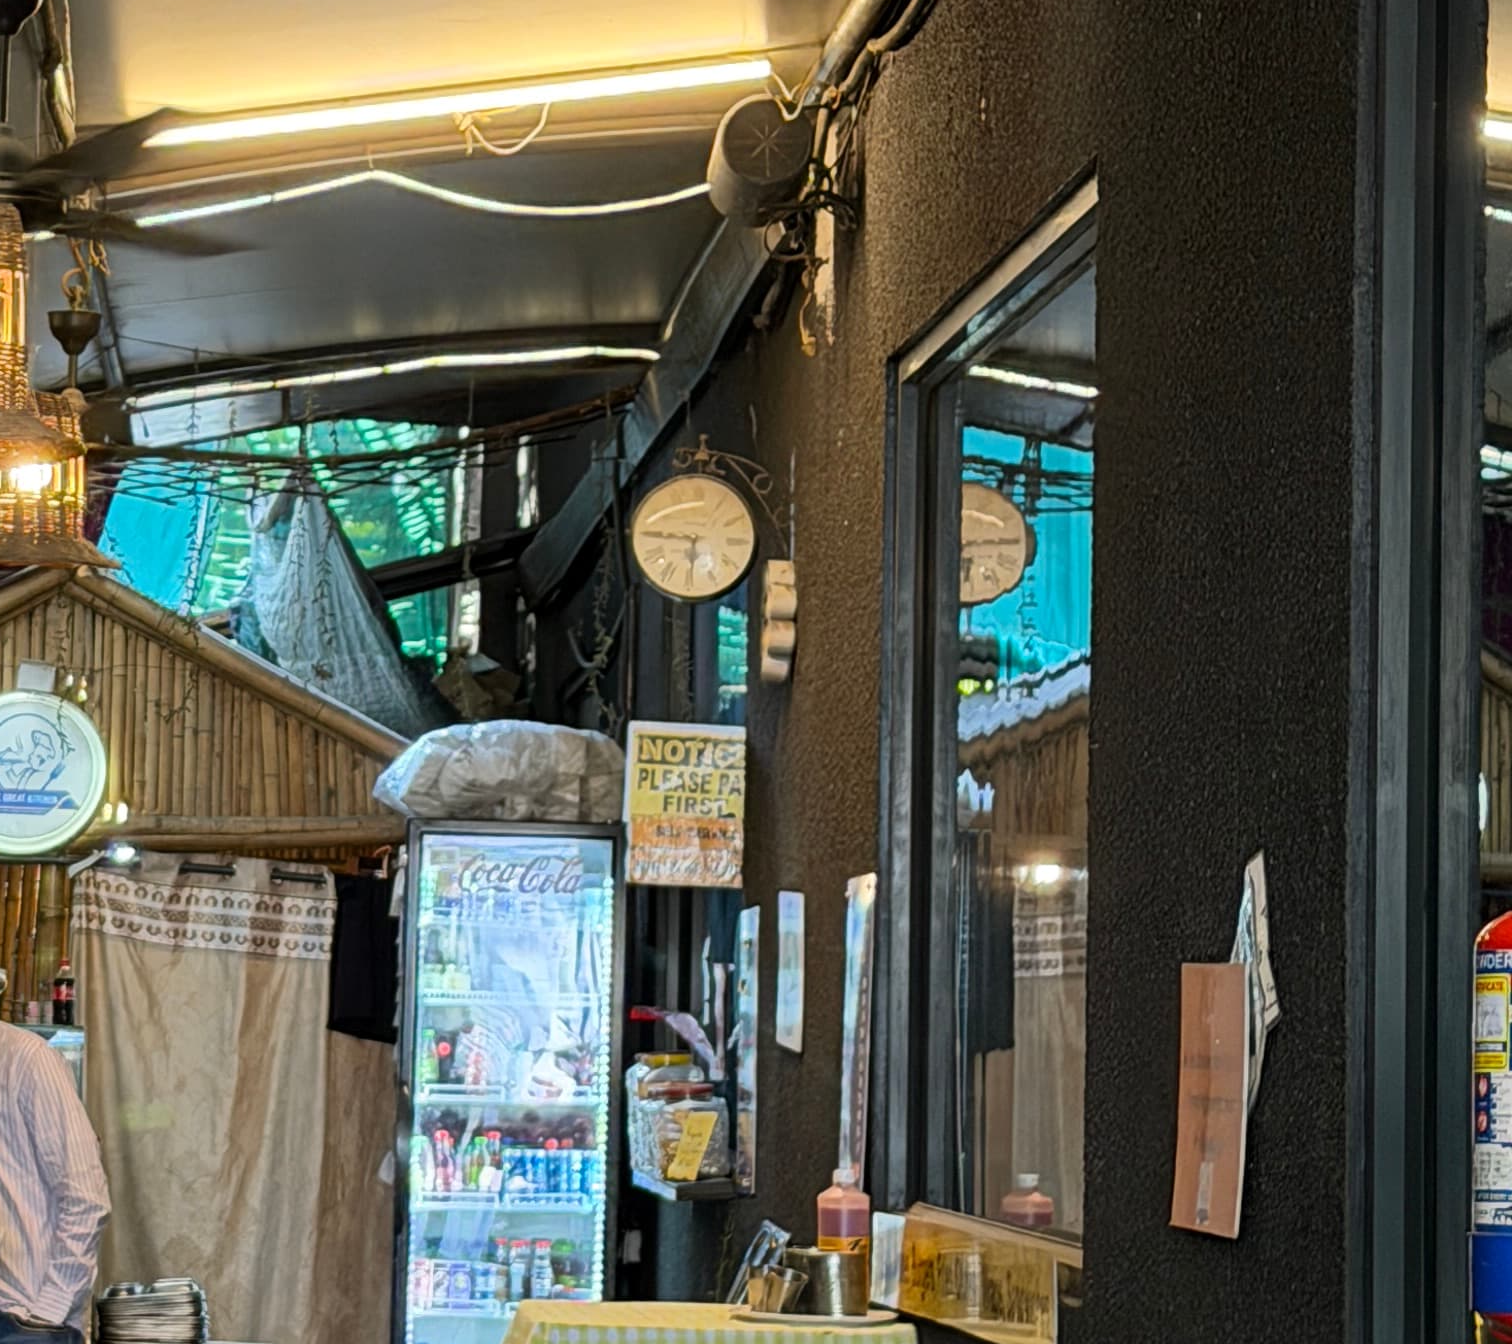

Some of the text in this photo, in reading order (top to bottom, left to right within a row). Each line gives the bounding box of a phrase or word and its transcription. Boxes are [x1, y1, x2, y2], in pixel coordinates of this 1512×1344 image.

[640, 738, 746, 767] NOTIC
[638, 768, 742, 796] PLEASE PA
[459, 853, 583, 894] Coca-Cola
